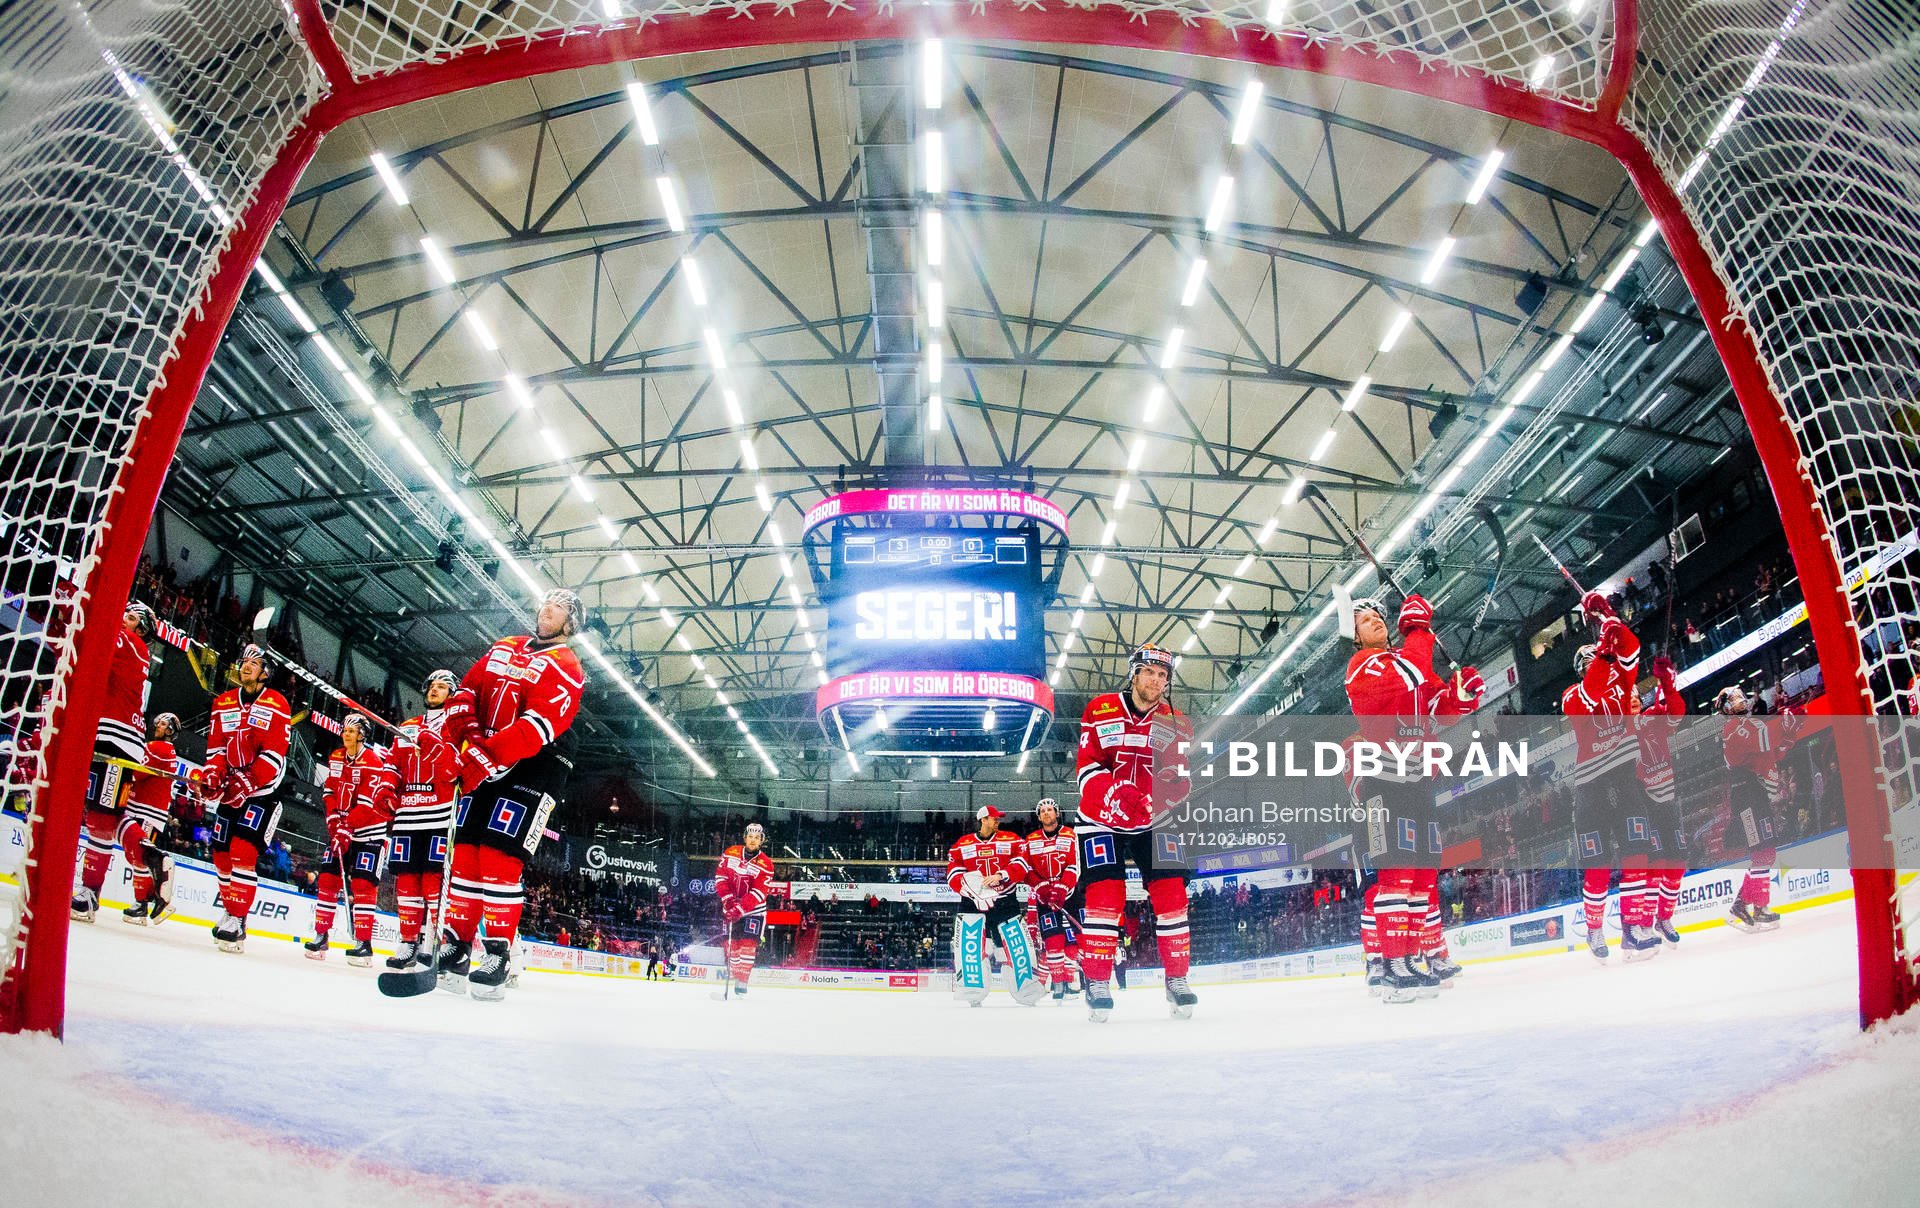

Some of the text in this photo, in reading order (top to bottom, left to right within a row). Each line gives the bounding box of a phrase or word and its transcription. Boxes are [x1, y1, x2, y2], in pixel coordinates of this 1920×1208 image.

[888, 495, 917, 510] DET
[921, 492, 941, 511] ÄR
[945, 495, 959, 510] VI
[963, 495, 996, 511] SOM
[1000, 493, 1020, 512] ÄR
[897, 541, 904, 551] 3
[968, 541, 975, 551] 0
[855, 591, 1017, 640] SEGER!
[1758, 606, 1803, 643] ByggTema
[284, 660, 348, 700] EASTON
[840, 674, 1034, 701] DET ÄR VI SOM ÄR ÖREBRO
[549, 684, 572, 717] 78
[586, 845, 658, 874] Gustavsvik
[1677, 880, 1733, 907] ISCATOR
[1787, 868, 1830, 893] bravida
[965, 929, 980, 985] HEROK
[1005, 925, 1029, 980] HEROK
[677, 965, 707, 979] ELON
[812, 975, 840, 985] Nolato
